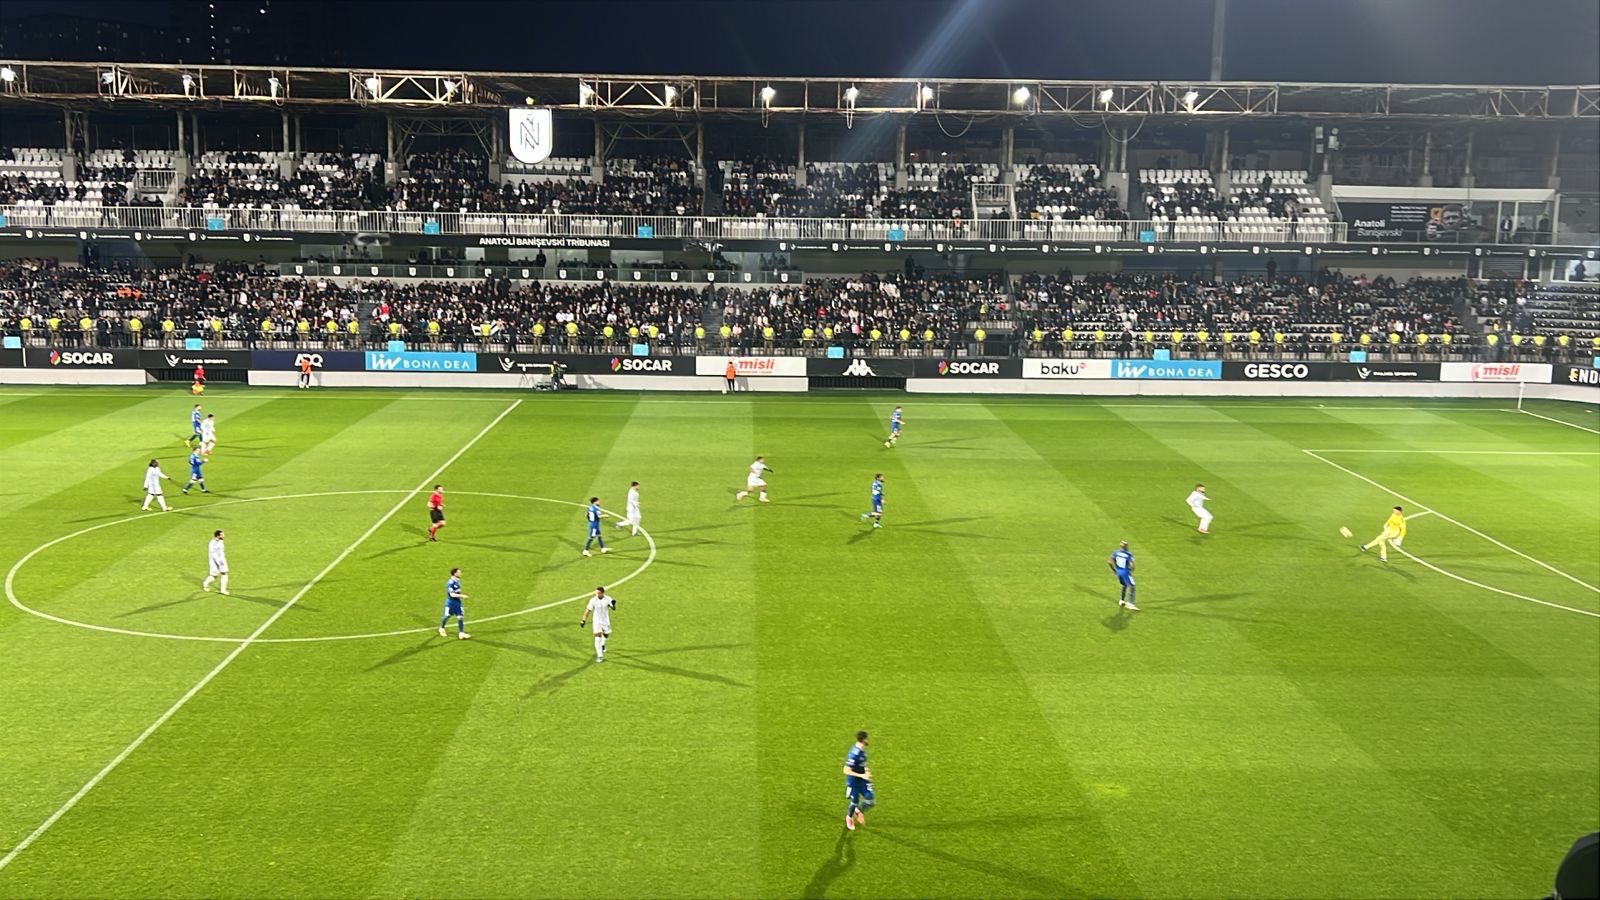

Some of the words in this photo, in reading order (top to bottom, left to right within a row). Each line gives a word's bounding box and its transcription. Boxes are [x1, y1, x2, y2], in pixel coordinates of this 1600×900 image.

[1354, 219, 1385, 228] Anatoli
[479, 236, 515, 246] ANATOLİ
[62, 352, 113, 365] SOCAR
[403, 360, 440, 369] BONA
[443, 360, 470, 369] DEA
[738, 358, 776, 369] misli
[623, 359, 673, 371] SOCAR
[949, 362, 999, 374] SOCAR
[1041, 362, 1079, 375] baku
[1244, 363, 1309, 378] GESCO
[1483, 364, 1520, 376] misli
[1148, 368, 1184, 377] BONA
[1188, 368, 1213, 377] DEA
[1569, 367, 1600, 384] END
